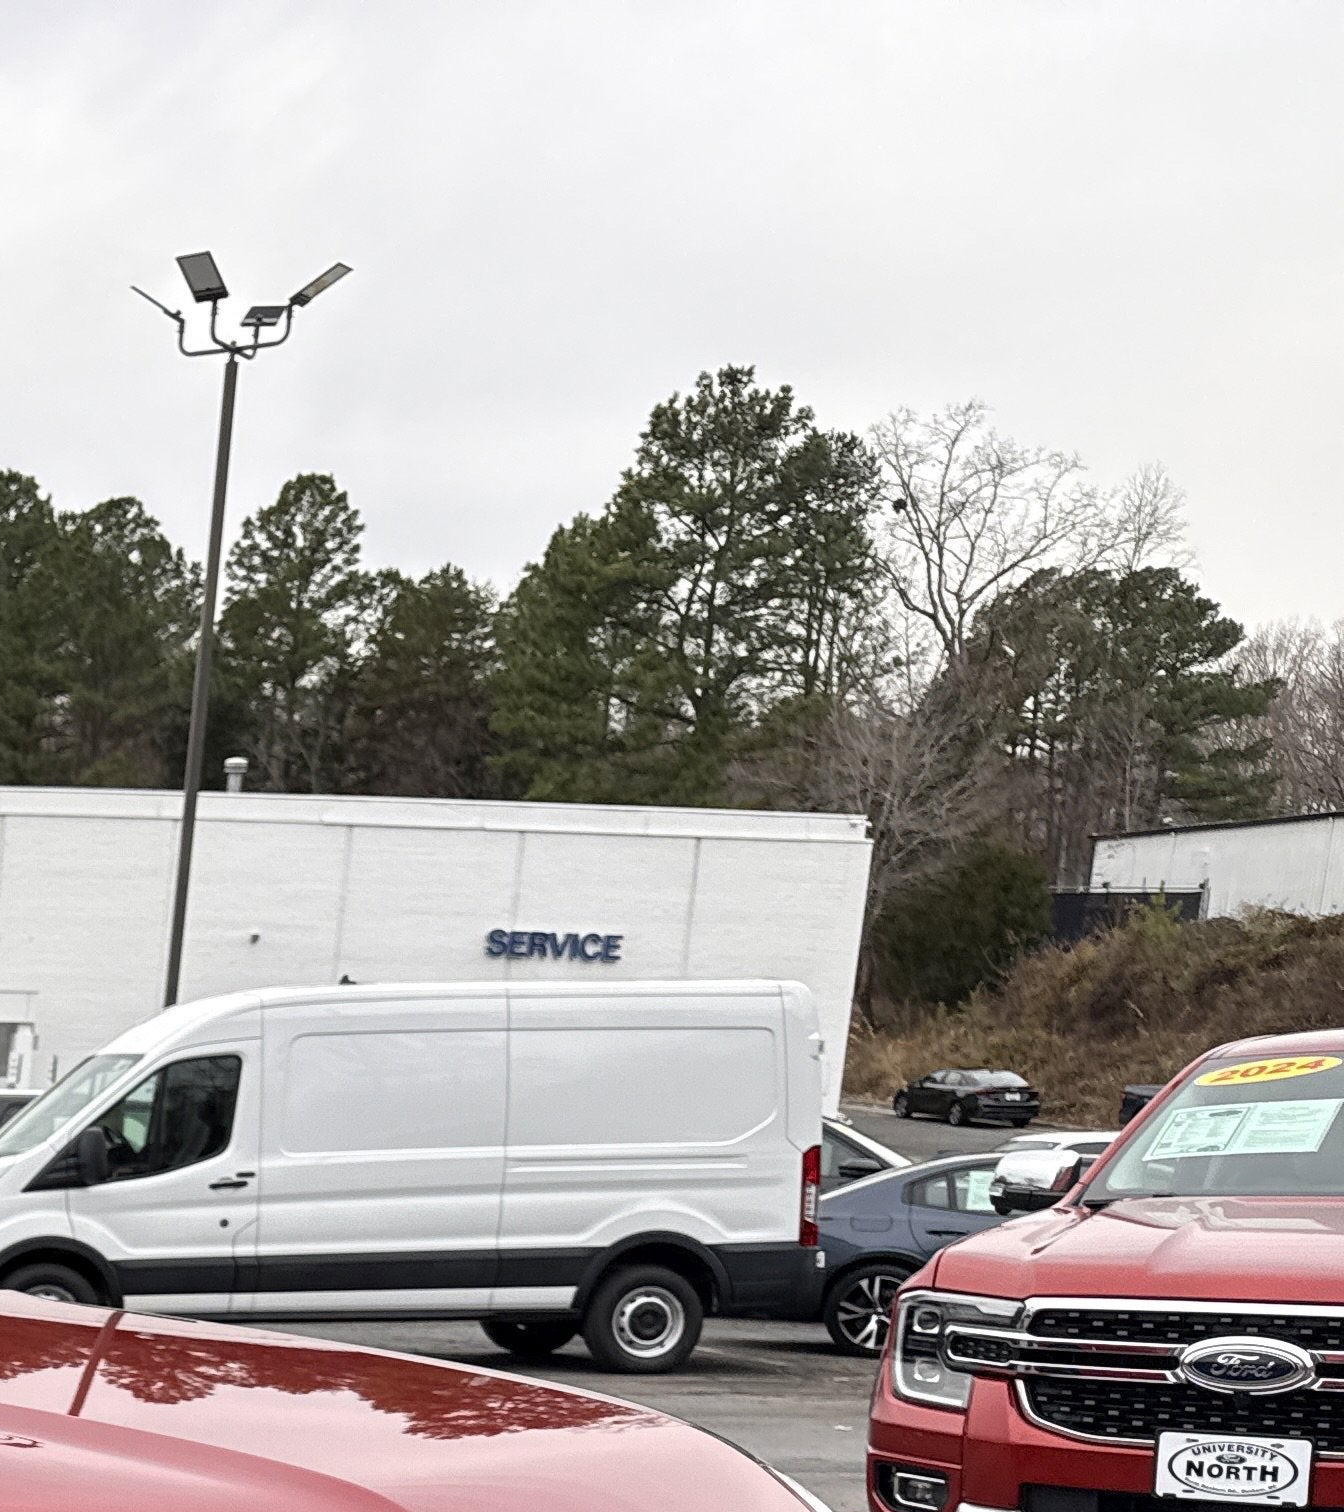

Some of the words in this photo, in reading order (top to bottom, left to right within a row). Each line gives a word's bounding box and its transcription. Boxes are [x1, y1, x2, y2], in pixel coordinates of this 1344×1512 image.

[486, 929, 624, 963] SERVICE
[1210, 1058, 1326, 1084] 2024
[1209, 1353, 1276, 1379] Ford
[1192, 1443, 1278, 1461] UNIVERSITY
[1185, 1459, 1280, 1483] NORTH
